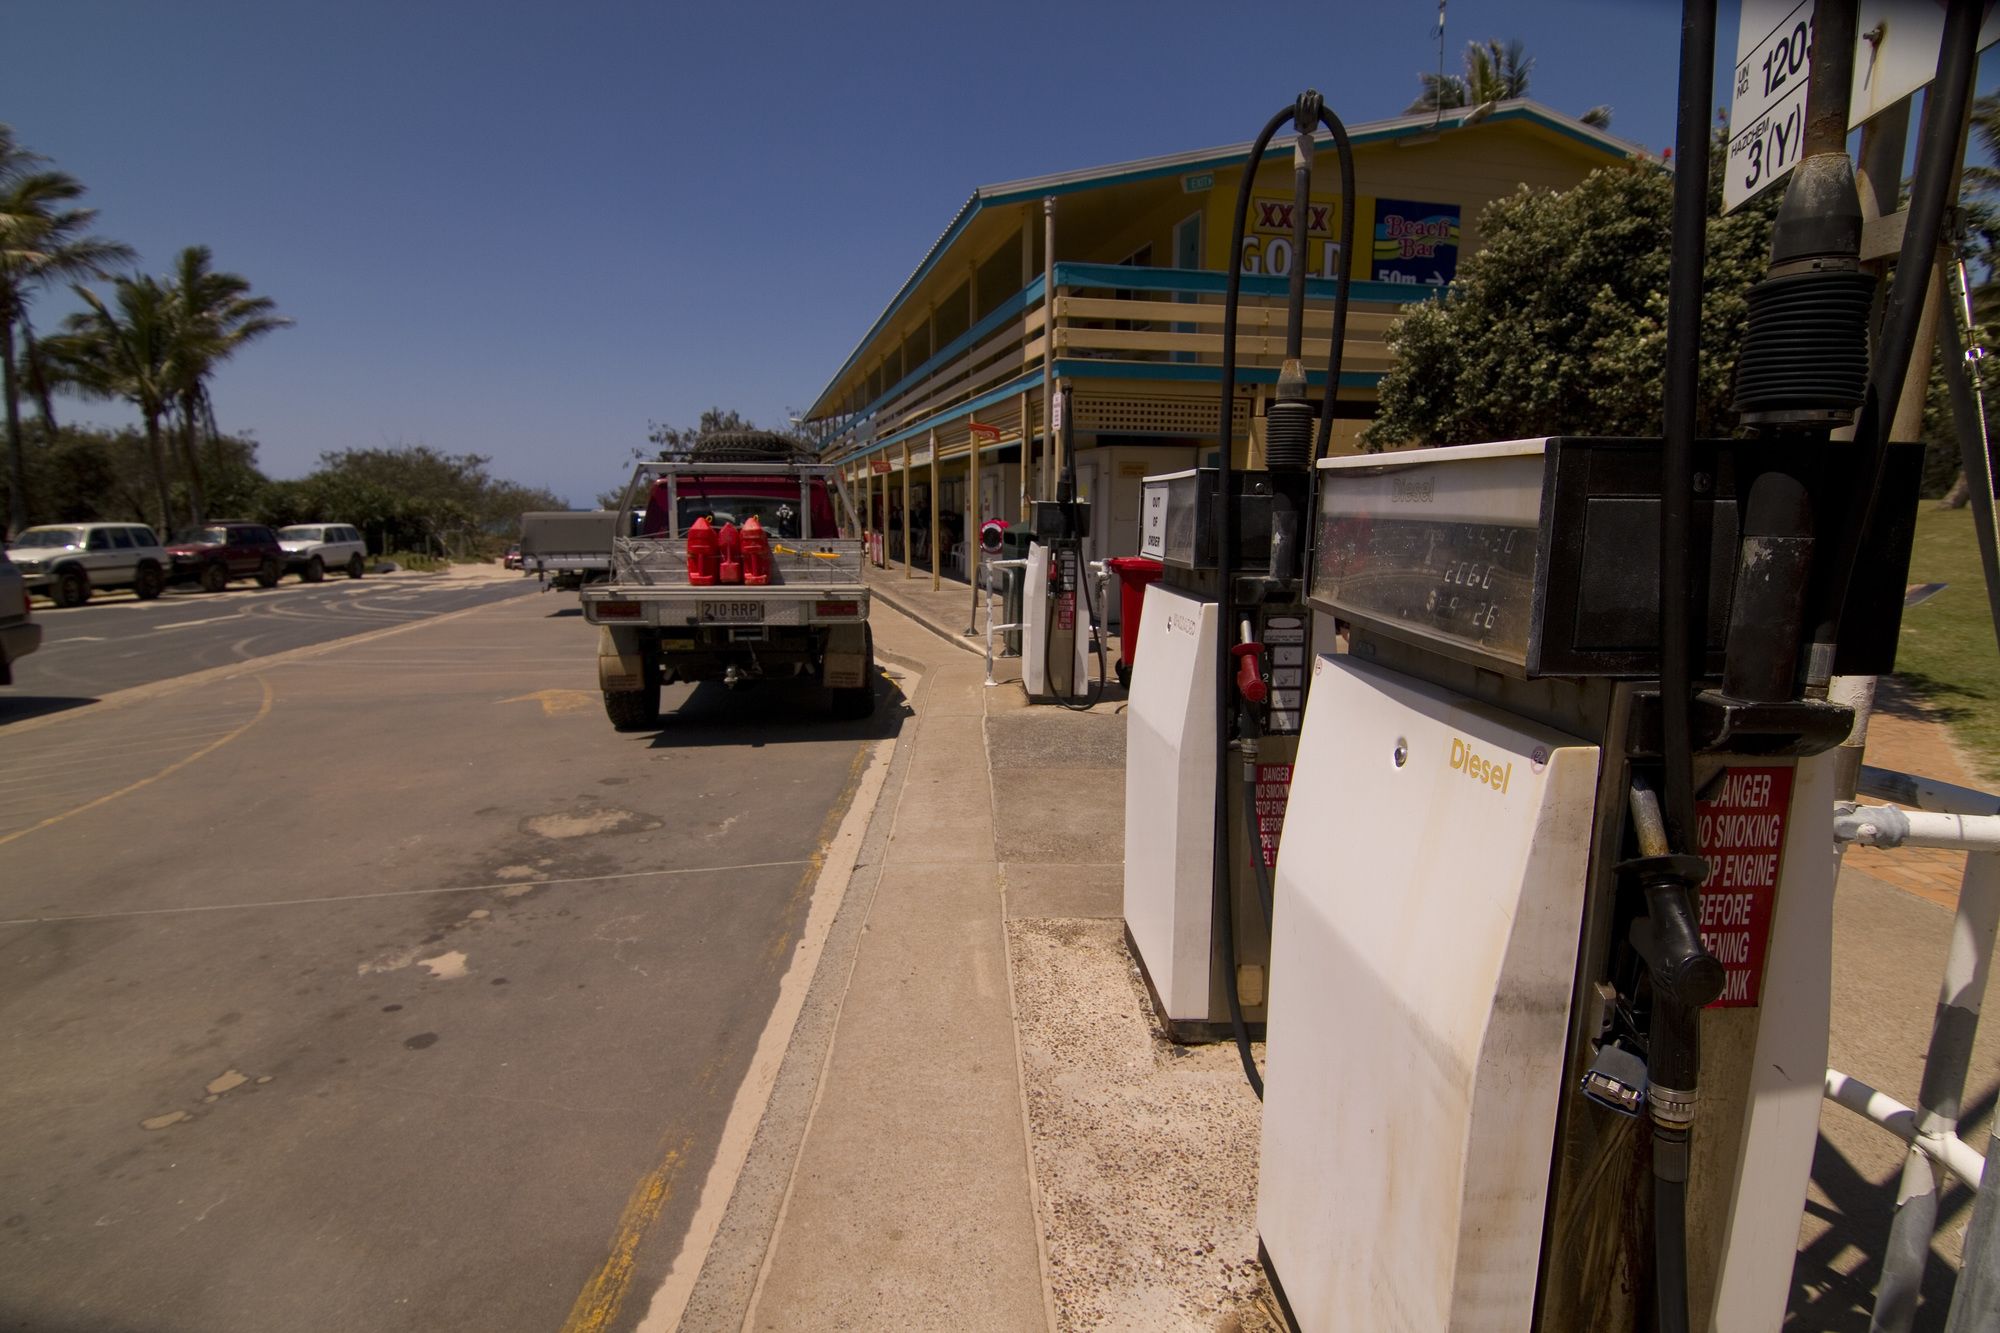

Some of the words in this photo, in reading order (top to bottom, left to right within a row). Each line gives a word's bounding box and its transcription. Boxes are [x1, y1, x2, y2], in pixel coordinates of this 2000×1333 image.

[1762, 19, 1811, 98] 120
[1738, 63, 1750, 84] UN
[1730, 116, 1770, 159] HAZCHEM
[1385, 215, 1452, 240] Beach
[1399, 237, 1438, 260] Bar
[1378, 269, 1417, 284] 50m
[1152, 496, 1161, 508] OUT
[1391, 476, 1436, 504] Diesel
[1152, 516, 1159, 528] OF
[1263, 767, 1290, 782] DANGER
[1450, 737, 1512, 796] Diesel
[1710, 774, 1772, 808] ANGER
[1715, 814, 1780, 848] SMOKING
[1723, 854, 1778, 887] ENGINE
[1699, 893, 1753, 926] BEFORE
[1719, 970, 1752, 1001] ANK
